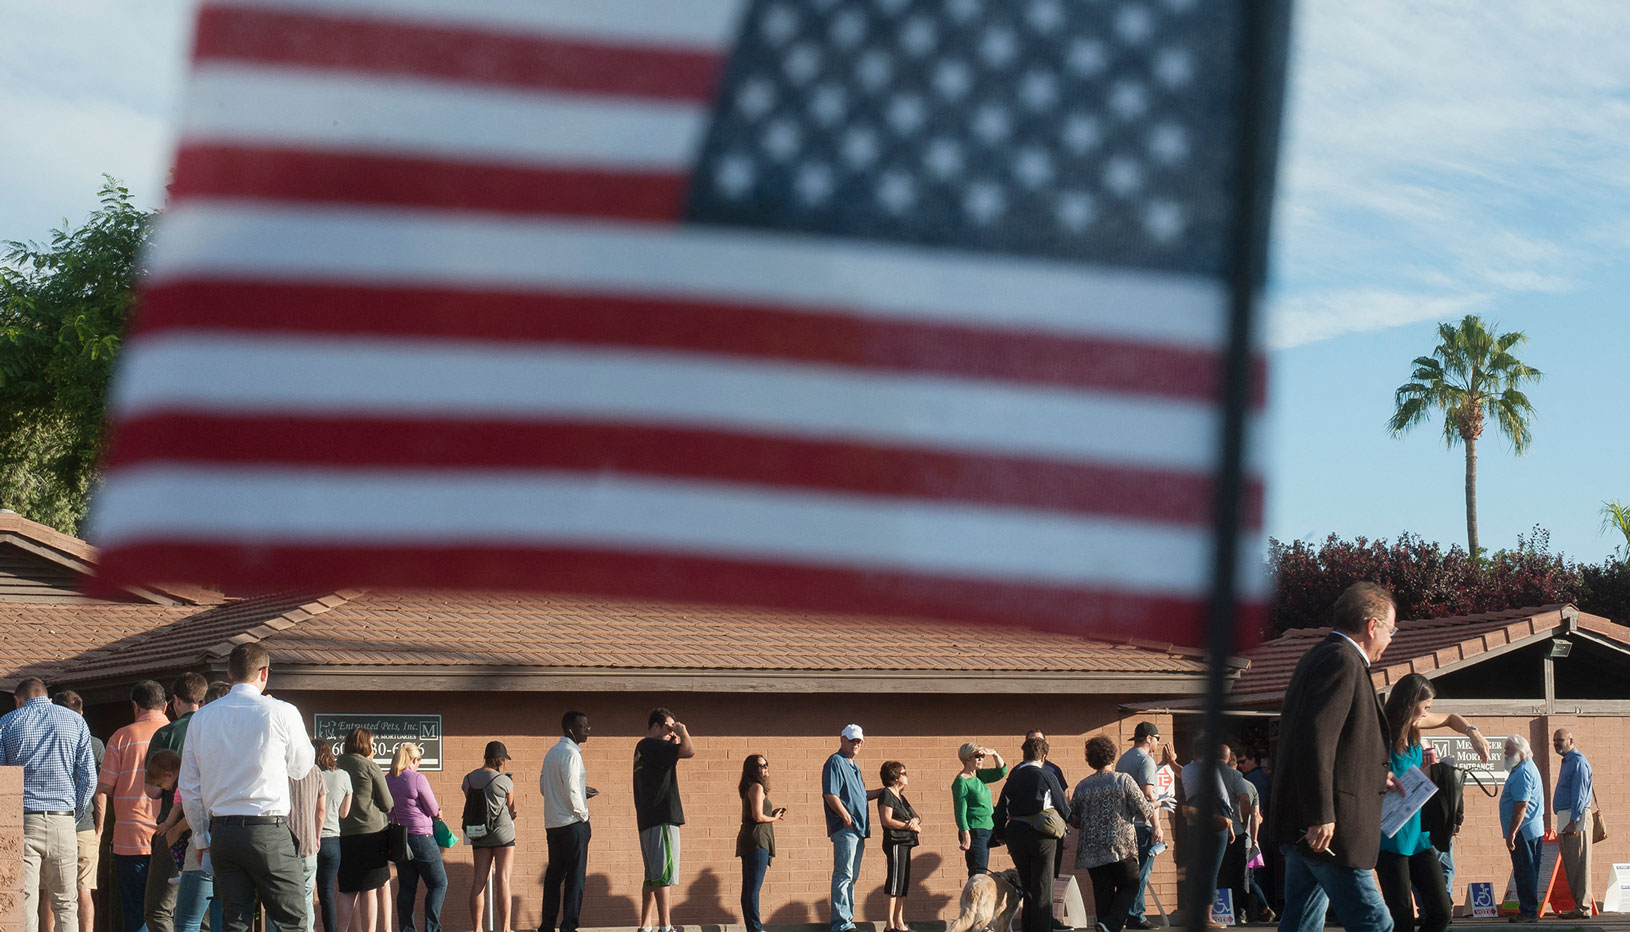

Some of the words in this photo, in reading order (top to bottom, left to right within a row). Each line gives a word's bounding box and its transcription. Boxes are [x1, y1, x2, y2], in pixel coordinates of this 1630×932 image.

[381, 721, 401, 731] Pets,
[403, 721, 418, 730] Inc.
[422, 724, 436, 738] M
[1434, 743, 1448, 758] M
[1459, 763, 1495, 771] ENTRANCE
